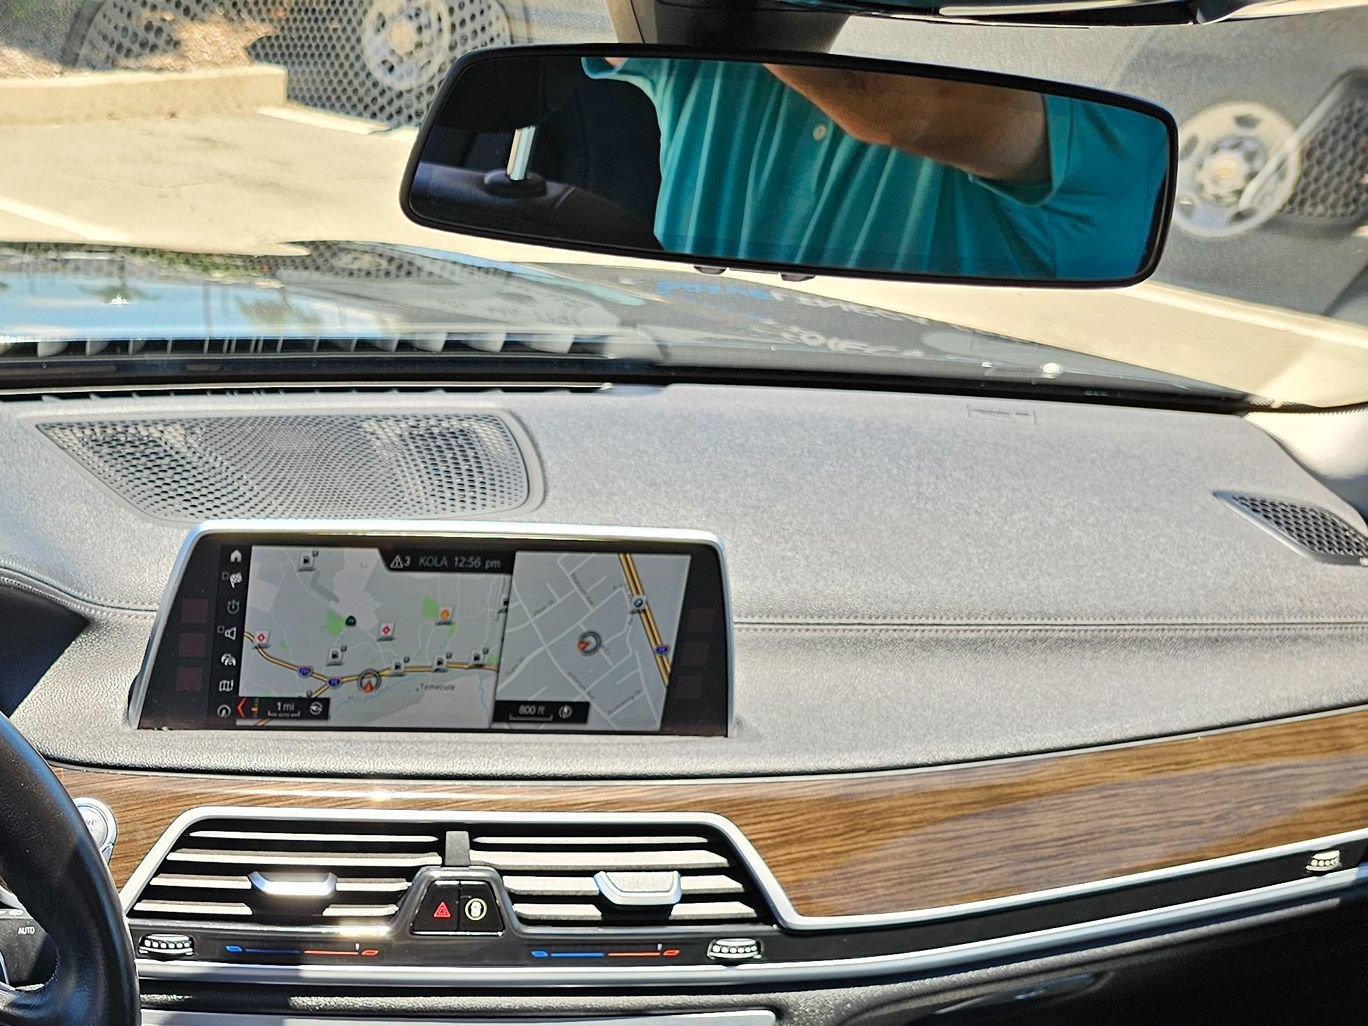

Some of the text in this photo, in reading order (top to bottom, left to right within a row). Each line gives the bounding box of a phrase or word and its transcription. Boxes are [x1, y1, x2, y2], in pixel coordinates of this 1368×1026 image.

[454, 556, 481, 568] 12:56
[485, 559, 501, 570] pm
[277, 702, 282, 711] 1
[519, 704, 536, 715] 800
[18, 926, 35, 935] AUTO
